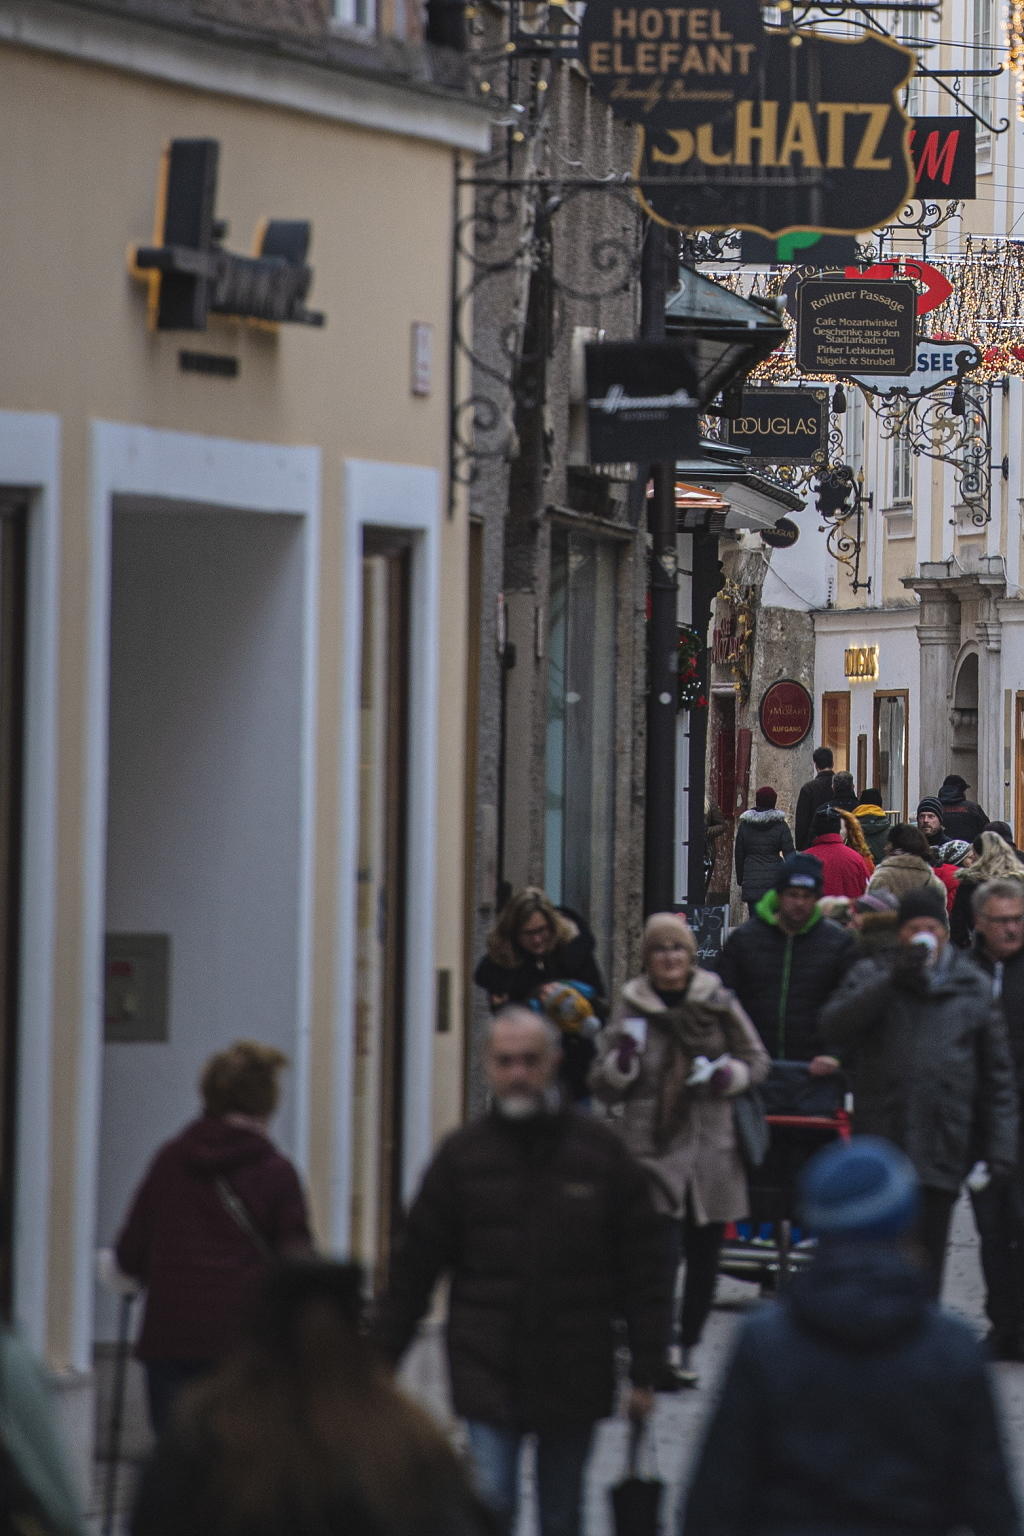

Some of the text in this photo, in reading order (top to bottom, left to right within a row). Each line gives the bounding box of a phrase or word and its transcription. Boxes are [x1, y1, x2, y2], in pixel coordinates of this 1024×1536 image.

[612, 8, 733, 40] HOTEL
[588, 41, 757, 76] ELEFANT
[810, 289, 905, 312] Roittner Passage
[839, 318, 898, 327] Mozartwinkel
[813, 327, 900, 337] Geschenke aus den
[825, 335, 887, 345] Stadtarkaden
[845, 345, 895, 356] Lebkuchen
[850, 357, 859, 365] &
[732, 417, 817, 436] DOUGLAS
